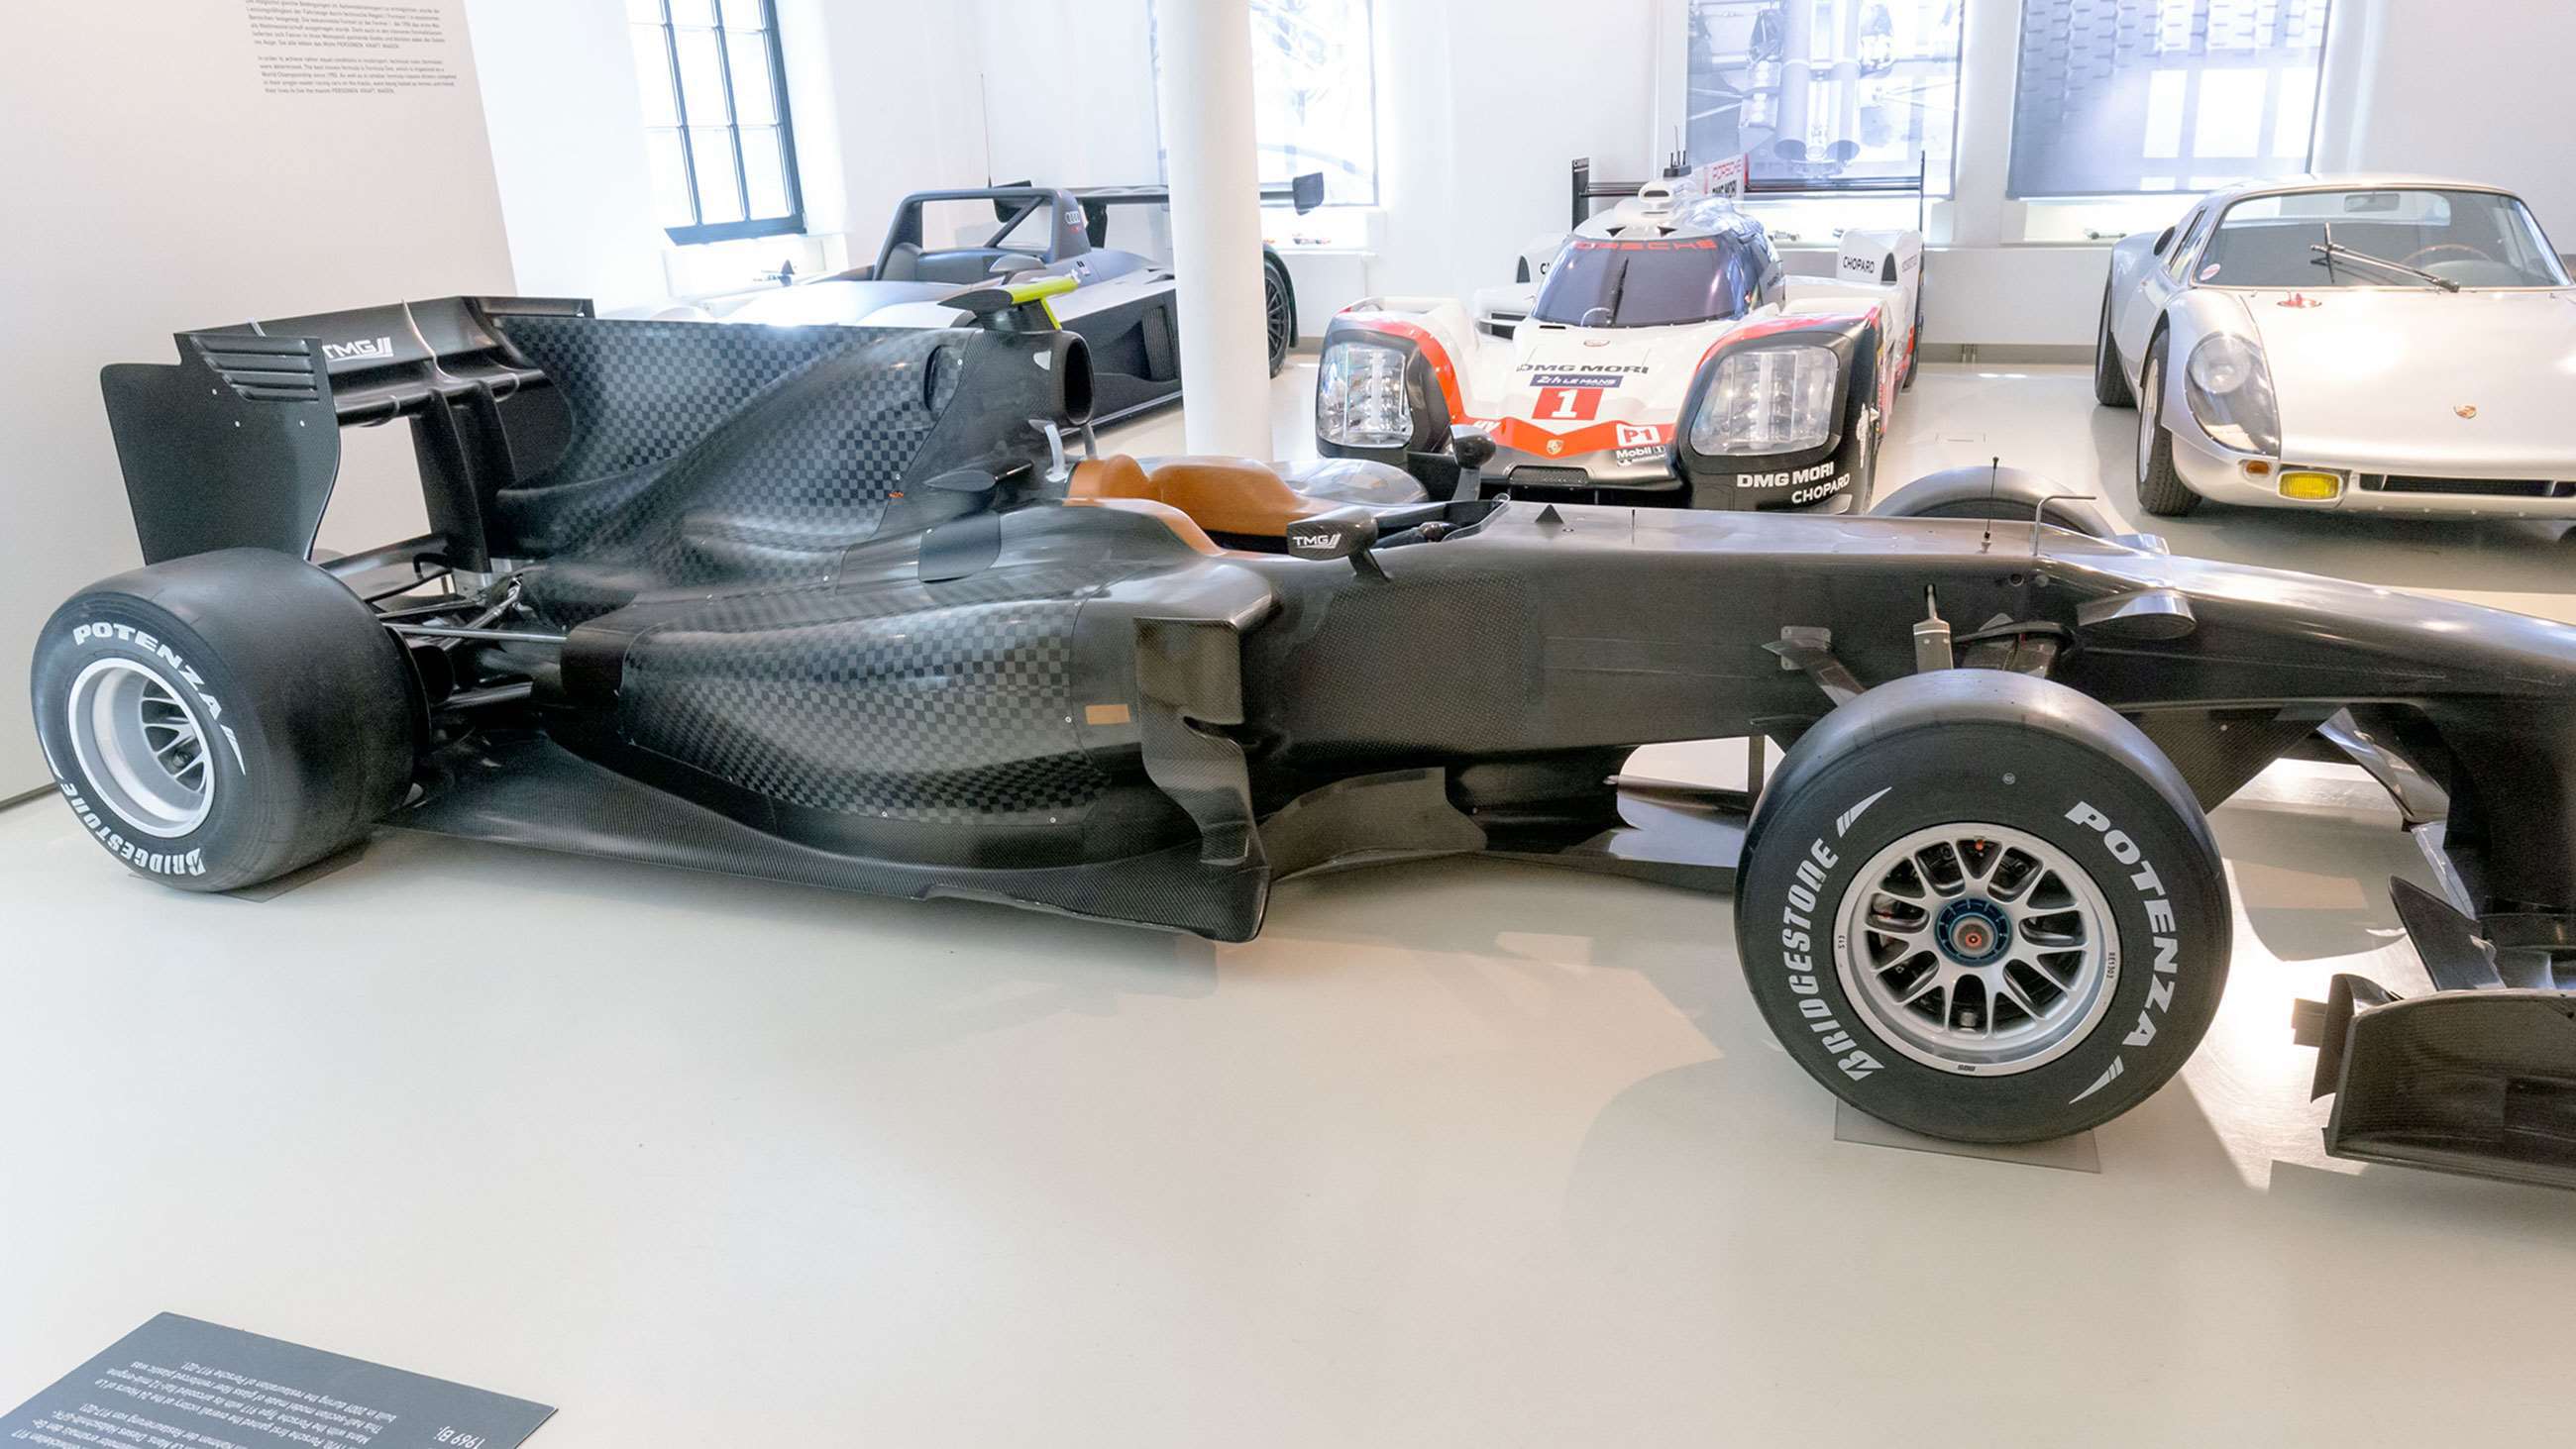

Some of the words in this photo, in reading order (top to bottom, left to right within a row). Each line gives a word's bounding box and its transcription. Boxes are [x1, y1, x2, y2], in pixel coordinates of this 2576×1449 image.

[1843, 256, 1875, 273] CHOPARD
[1516, 363, 1575, 372] DMG
[1580, 364, 1650, 374] MORI
[1552, 388, 1578, 418] 1
[1624, 427, 1654, 445] P1
[1616, 447, 1652, 459] Mobil
[1737, 473, 1789, 488] DMG
[1792, 462, 1835, 485] MORI
[1791, 473, 1850, 504] CHOPARD
[73, 621, 224, 723] POTENZA
[60, 782, 207, 877] BRIDGESTONE
[2065, 801, 2179, 1048] POTENZA
[1783, 838, 1885, 1082] BRIDGESTONE
[214, 1371, 247, 1384] Porsche
[265, 1397, 289, 1406] made
[304, 1394, 319, 1402] the
[318, 1396, 347, 1409] during
[259, 1409, 277, 1419] Type
[286, 1403, 316, 1413] model
[277, 1414, 313, 1429] Porsche
[375, 1412, 396, 1422] built
[268, 1426, 290, 1437] first
[364, 1423, 382, 1433] This
[433, 1426, 455, 1442] Bj.
[288, 1431, 324, 1446] Porsche
[346, 1432, 371, 1444] Mans
[450, 1433, 485, 1449] 1969
